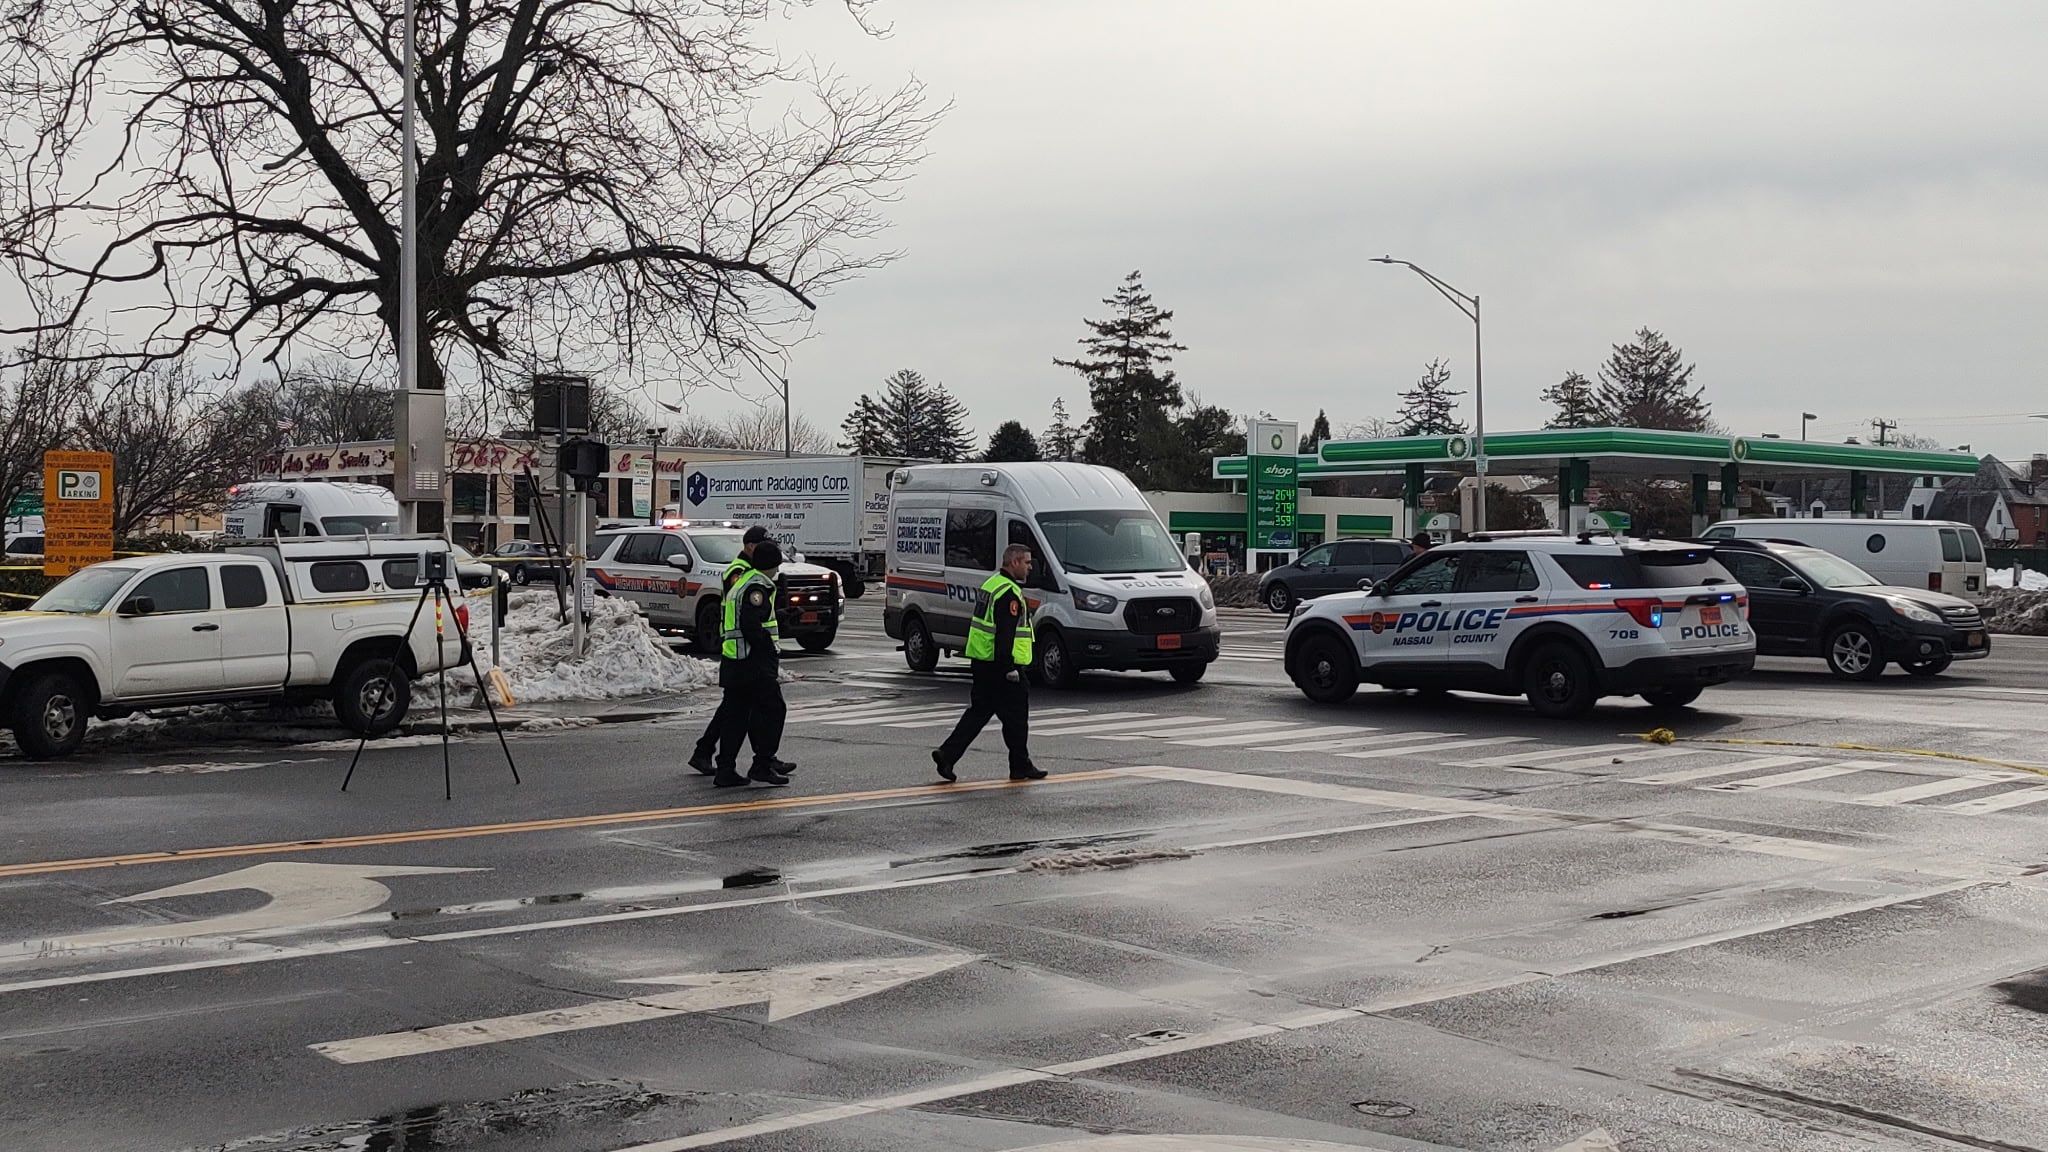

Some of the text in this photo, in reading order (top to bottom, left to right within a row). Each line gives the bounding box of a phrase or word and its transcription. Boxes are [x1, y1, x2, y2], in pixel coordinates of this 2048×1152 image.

[617, 453, 632, 472] &
[1263, 464, 1293, 478] shop
[695, 474, 700, 485] P
[709, 474, 850, 493] Paramount Packaging Corp.
[898, 516, 919, 524] NASSAU
[920, 516, 942, 525] COUNTY
[897, 526, 942, 540] CRIME SCENE
[896, 540, 941, 554] SEARCH UNIT
[615, 578, 673, 593] HIGHWAY PATROL
[1121, 580, 1184, 589] POLICE
[1396, 608, 1508, 633] POLICE
[1609, 630, 1639, 640] 708
[1680, 624, 1740, 640] POLICE
[1393, 633, 1498, 646] NASSAU COUNTY
